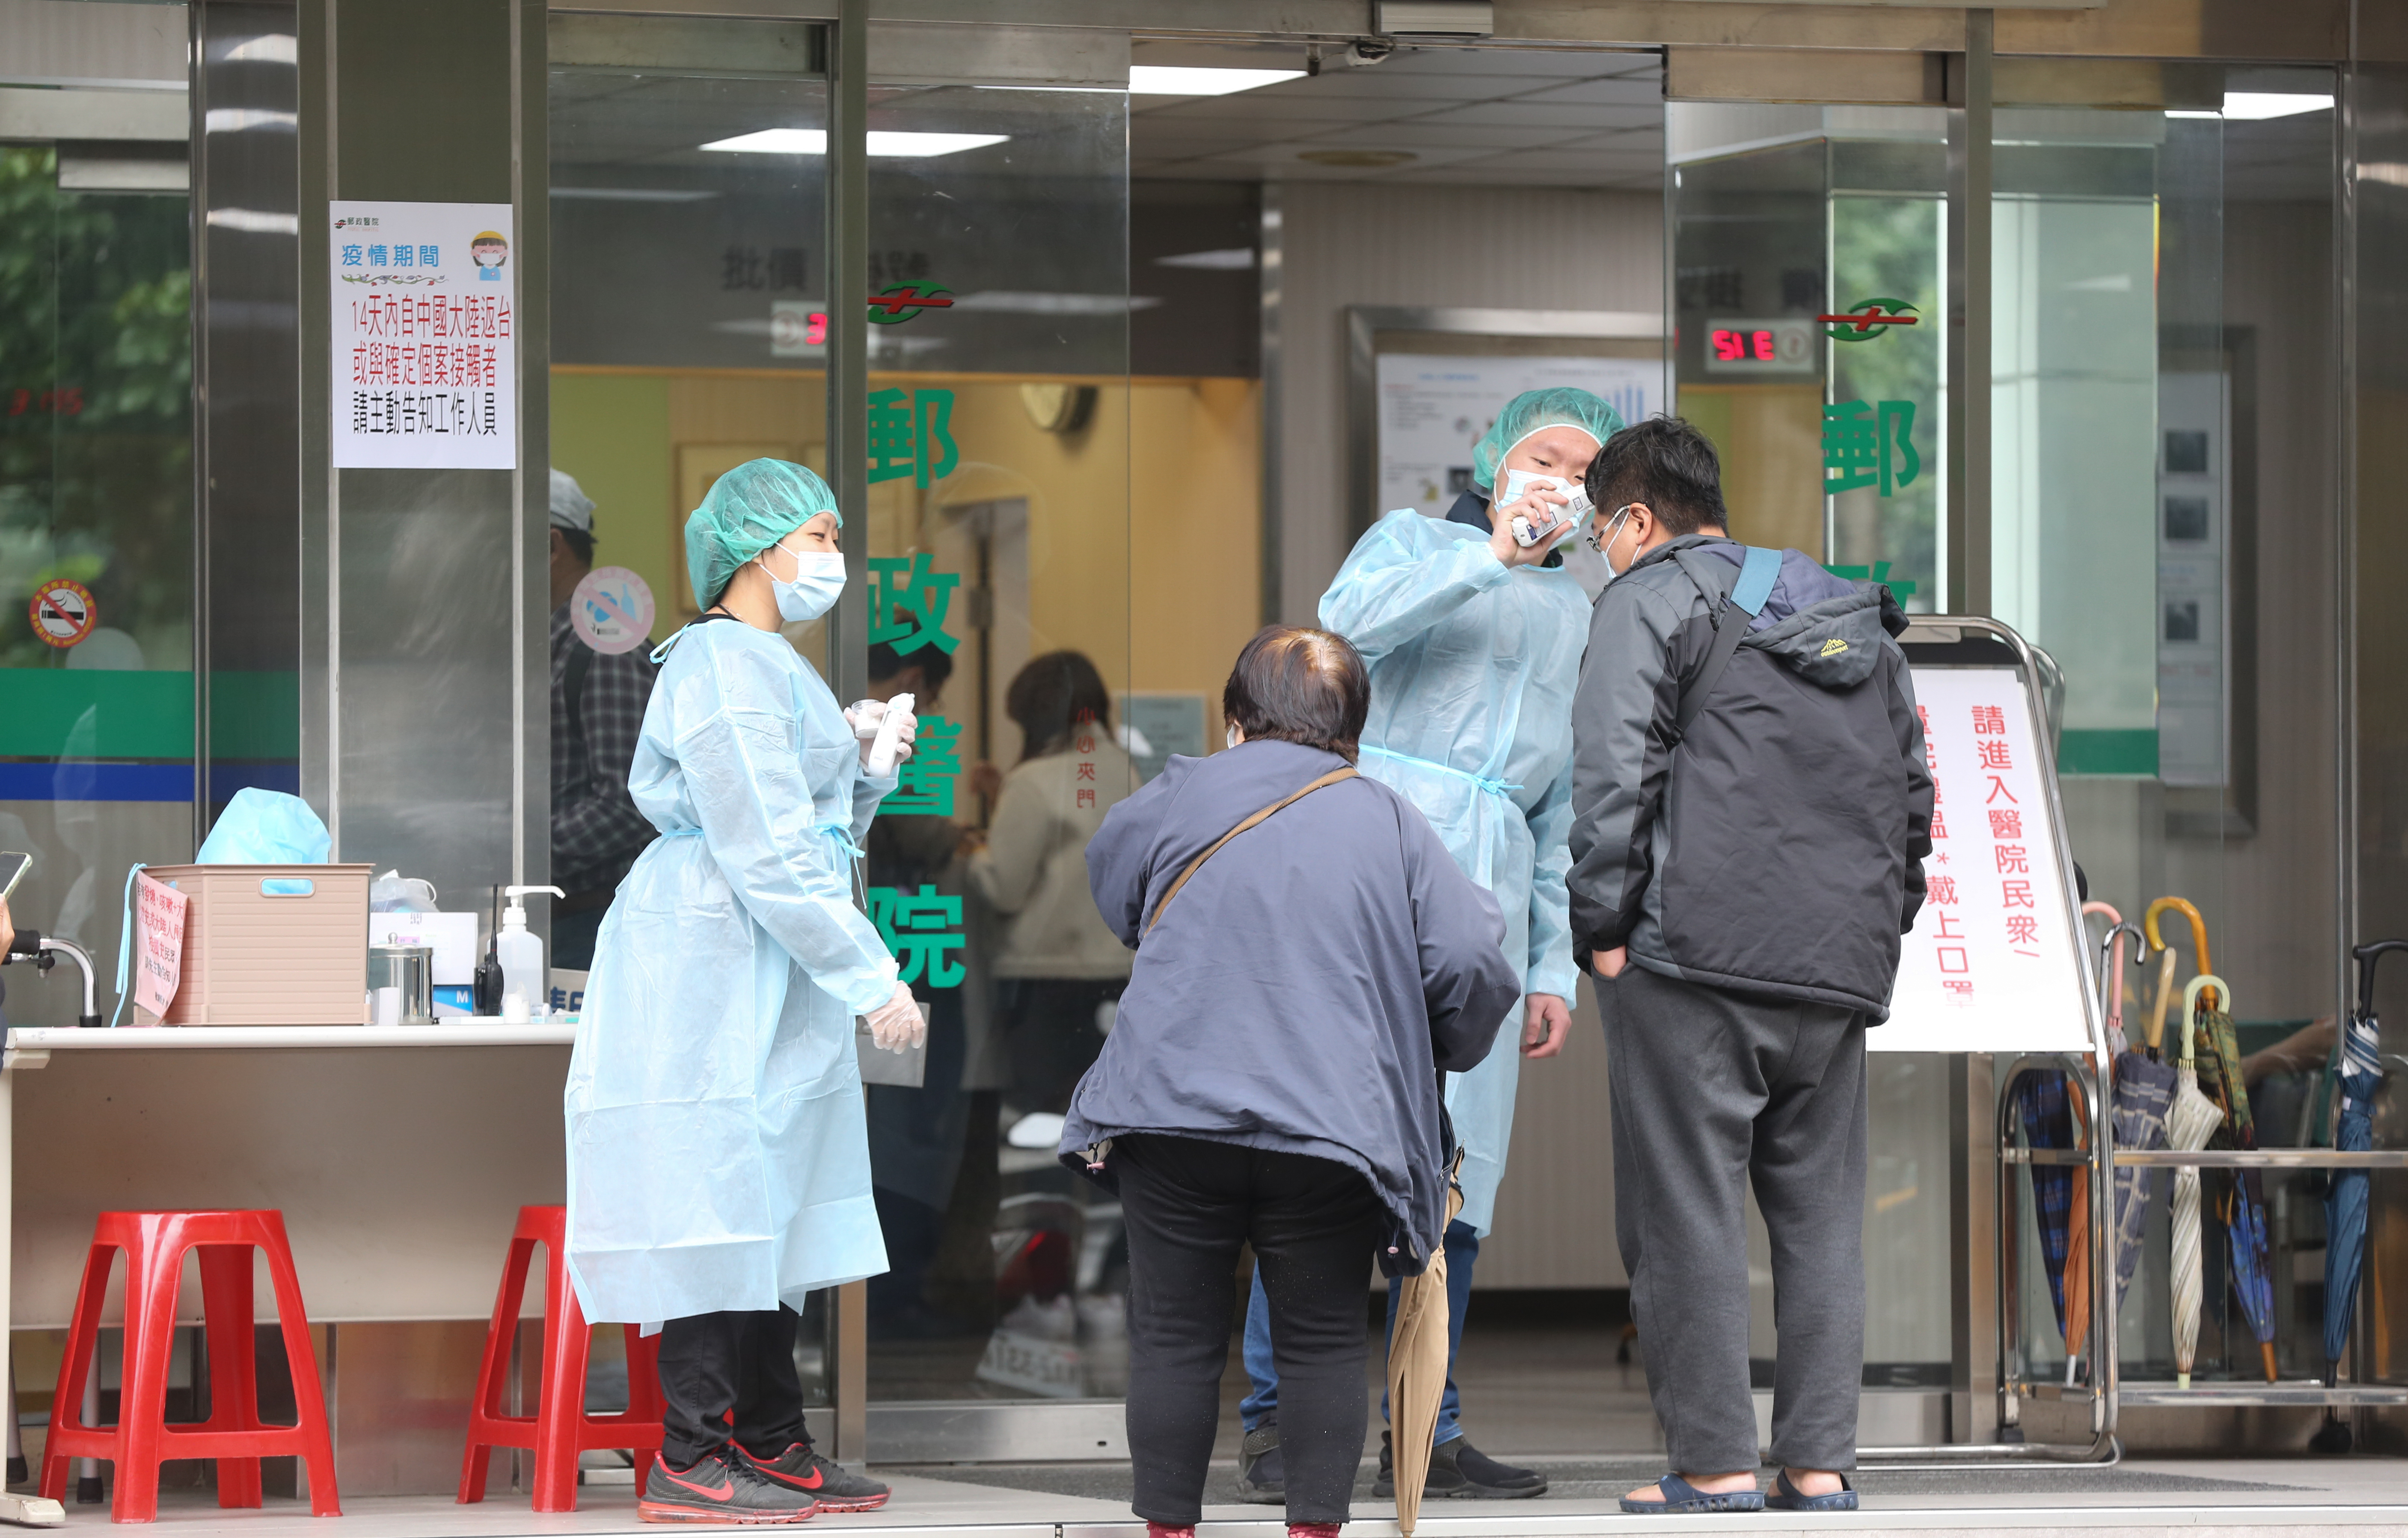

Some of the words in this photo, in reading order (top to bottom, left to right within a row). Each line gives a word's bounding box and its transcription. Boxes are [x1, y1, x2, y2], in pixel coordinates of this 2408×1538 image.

[342, 243, 439, 267] 疫情期間
[352, 294, 511, 339] 14天內自中國大陸返台
[353, 341, 496, 387] 或與確定個案接觸者
[353, 389, 497, 436] 請主動告知工作人員
[868, 387, 966, 988] 郵政醫院
[456, 990, 469, 1003] M
